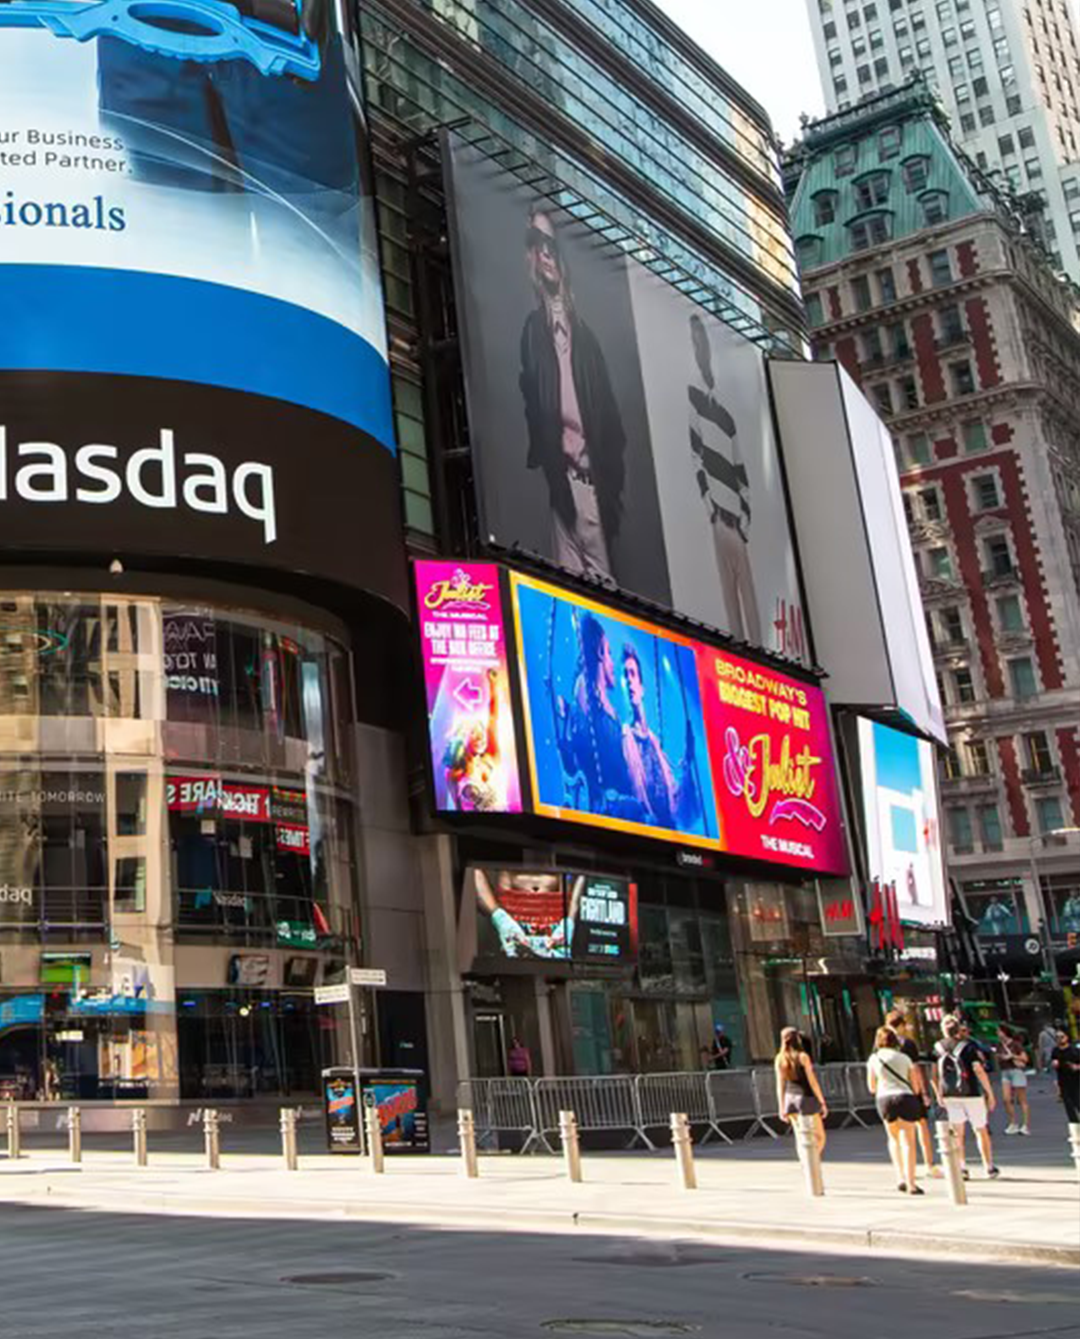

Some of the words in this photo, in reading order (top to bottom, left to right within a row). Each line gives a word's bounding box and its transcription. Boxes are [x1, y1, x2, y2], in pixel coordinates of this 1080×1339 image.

[45, 151, 133, 174] Partner.
[715, 658, 808, 706] BROADWAY'S
[744, 733, 822, 818] Juliet
